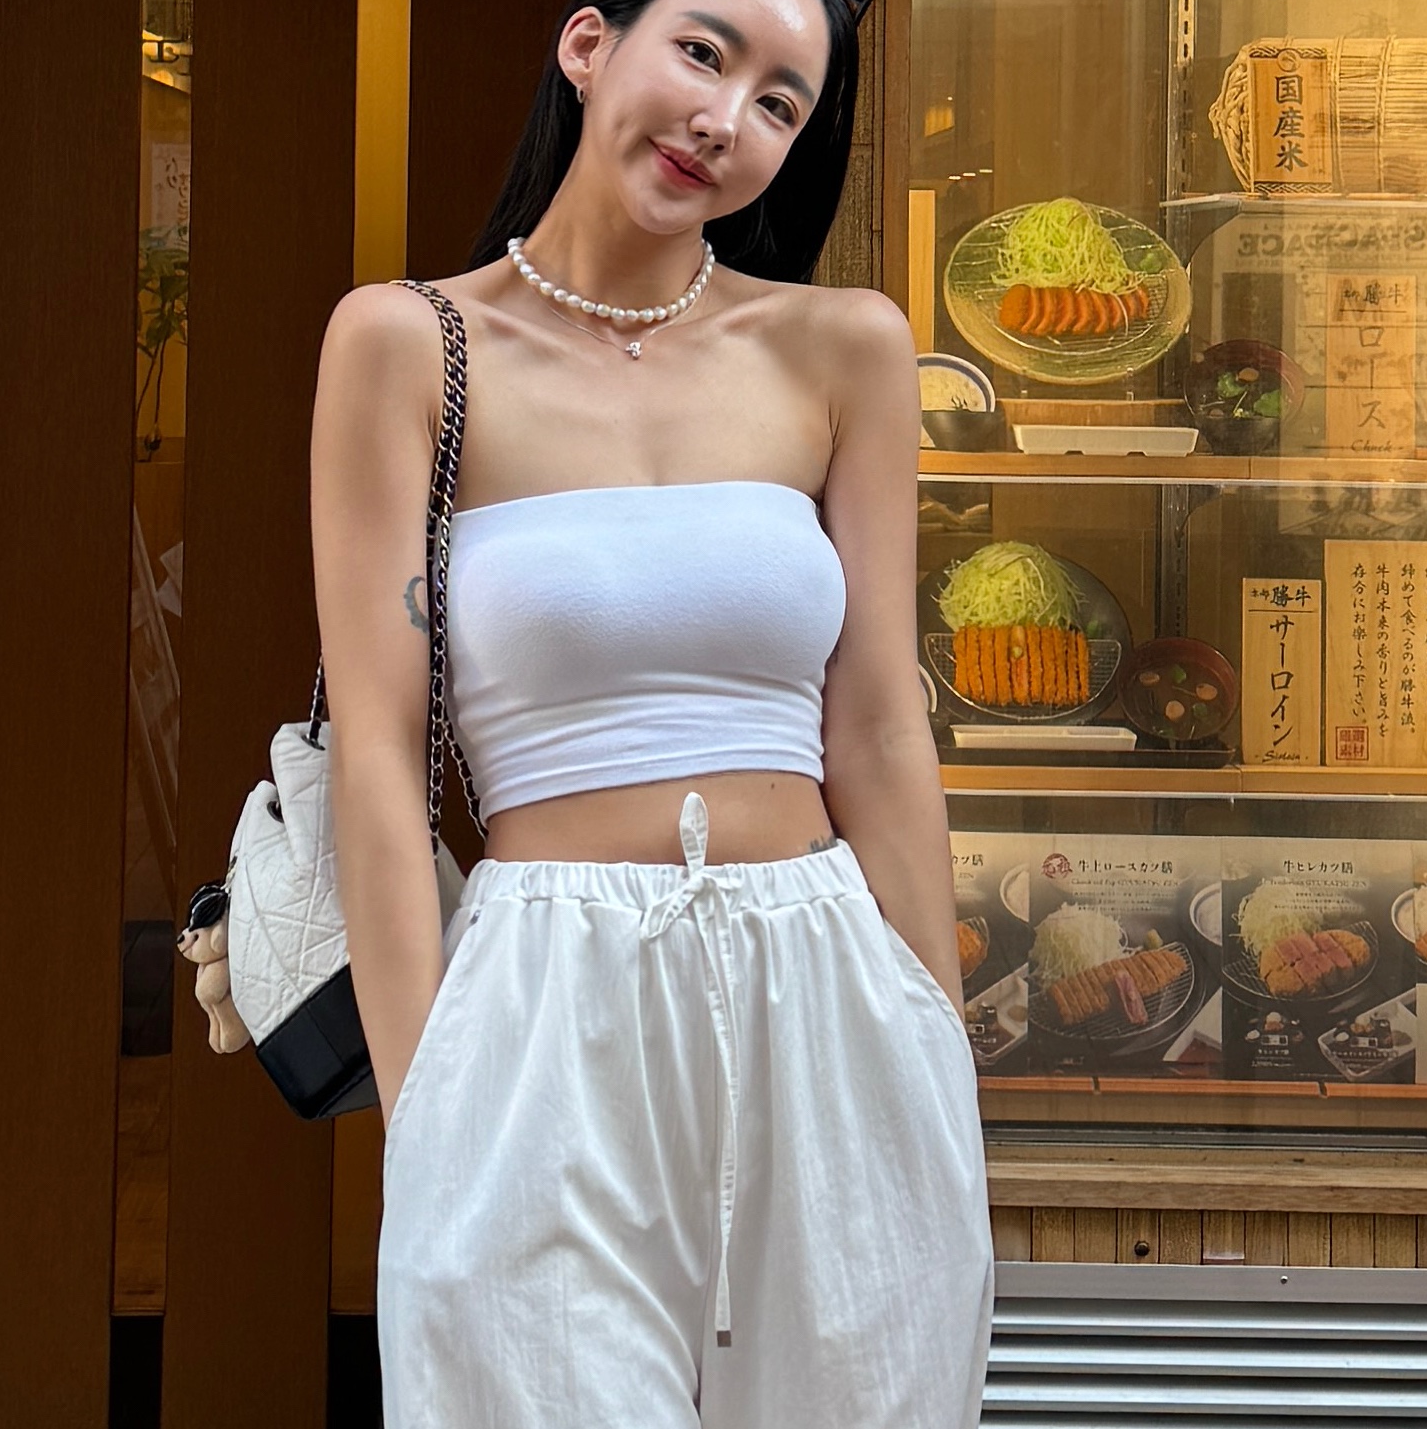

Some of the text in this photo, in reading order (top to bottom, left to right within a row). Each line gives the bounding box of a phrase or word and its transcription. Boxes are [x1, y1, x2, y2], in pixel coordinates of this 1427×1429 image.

[1272, 73, 1308, 171] 国産米
[1357, 326, 1386, 430] ロース
[1269, 613, 1295, 747] サーロイン
[1350, 562, 1368, 726] 存分にお楽しみ下さい。
